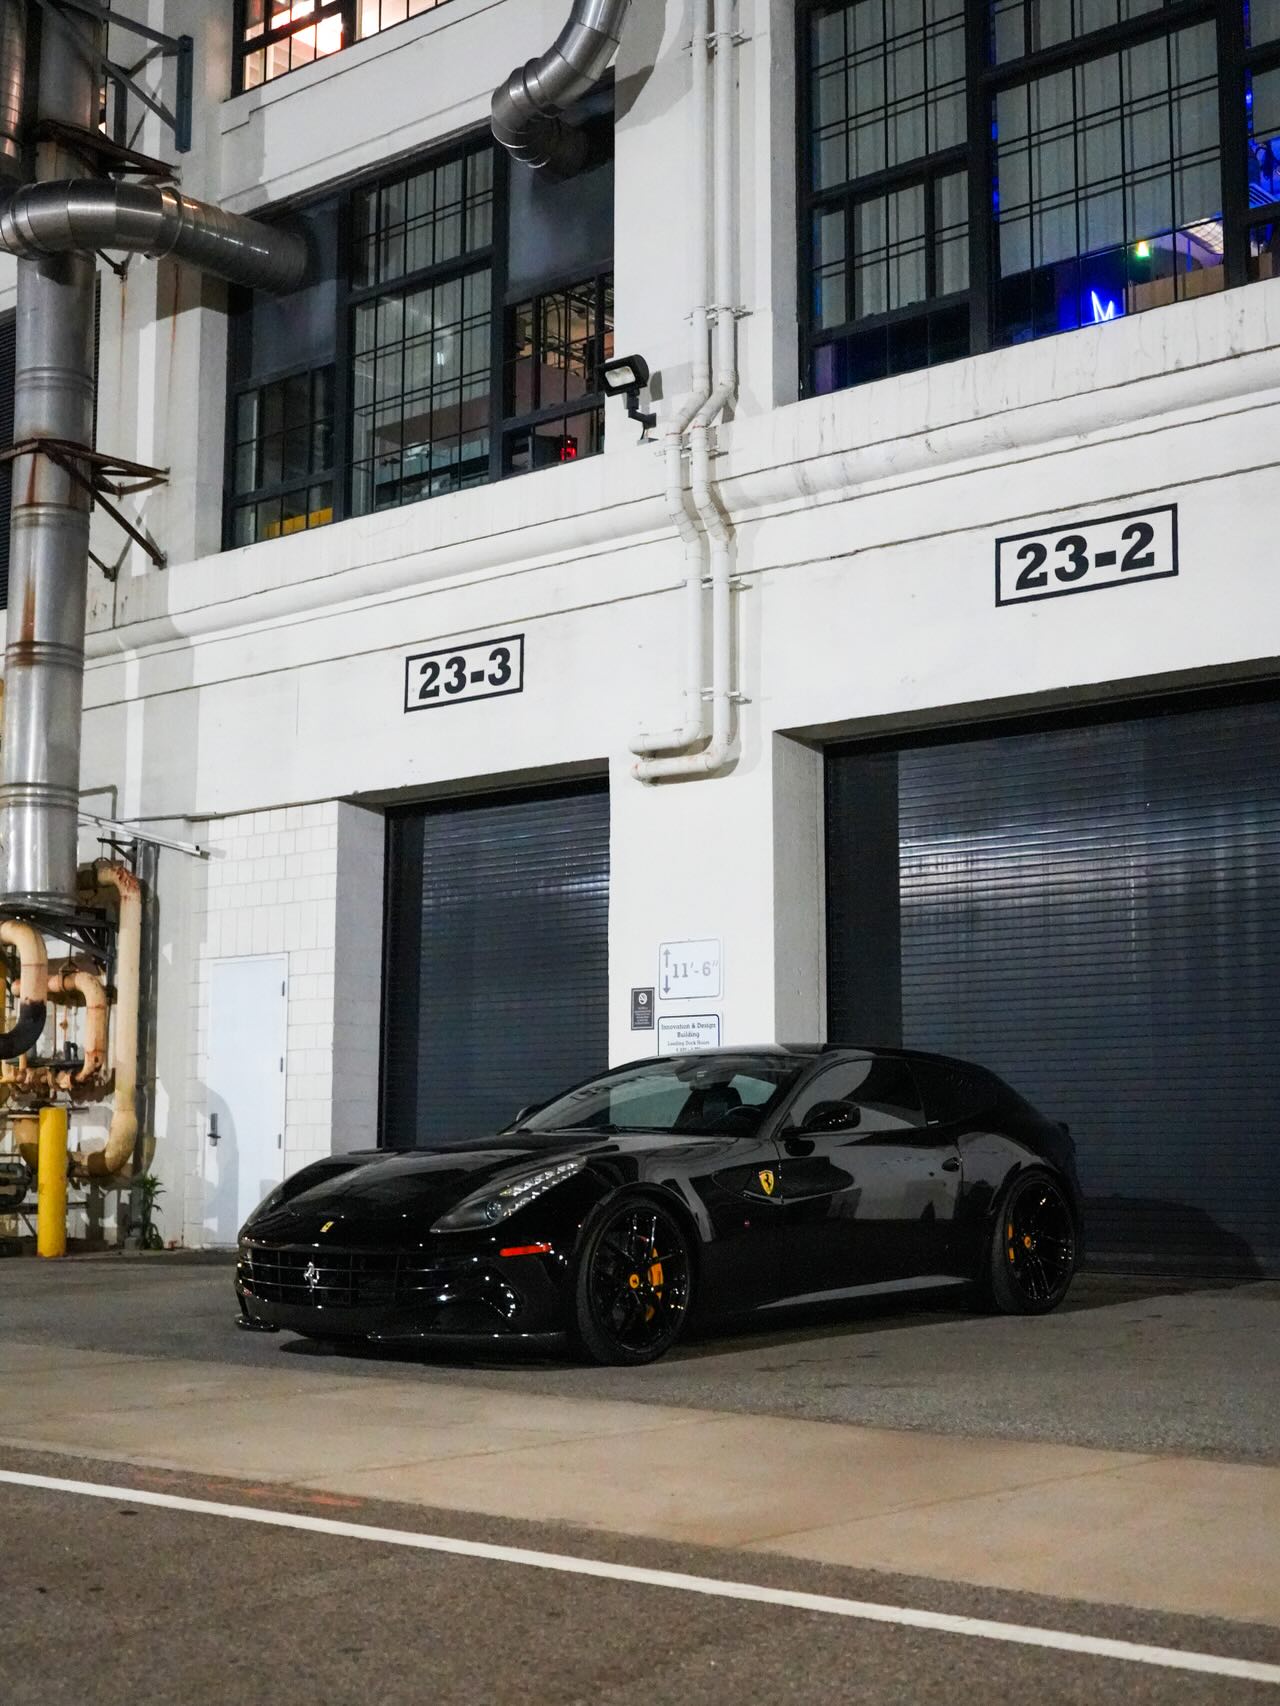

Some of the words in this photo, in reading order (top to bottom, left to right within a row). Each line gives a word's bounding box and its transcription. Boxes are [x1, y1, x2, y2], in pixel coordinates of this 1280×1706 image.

[1015, 522, 1155, 590] 23-2
[418, 647, 512, 700] 23-3
[661, 1023, 690, 1031] Innovation
[697, 1022, 716, 1030] Design
